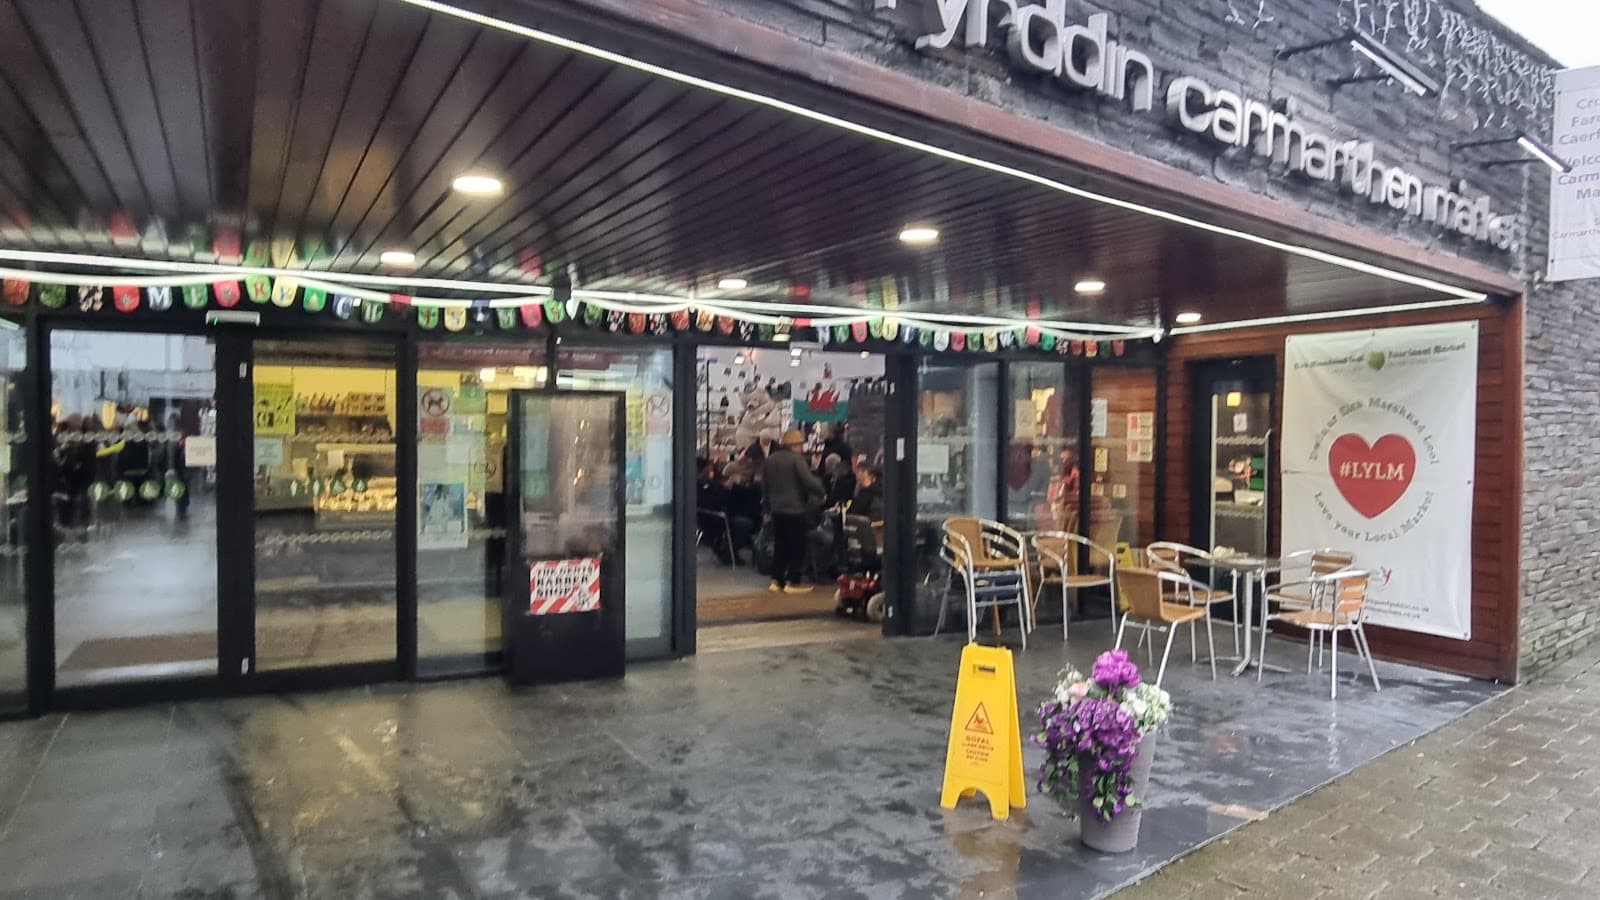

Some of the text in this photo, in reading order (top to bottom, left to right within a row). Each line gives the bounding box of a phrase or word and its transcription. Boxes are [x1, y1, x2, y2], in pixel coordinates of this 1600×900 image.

[874, 0, 1153, 111] yrddin
[1166, 75, 1423, 217] carmarthen
[1340, 461, 1405, 480] #LYLM
[537, 576, 588, 586] BARBER
[537, 587, 571, 597] SHOP
